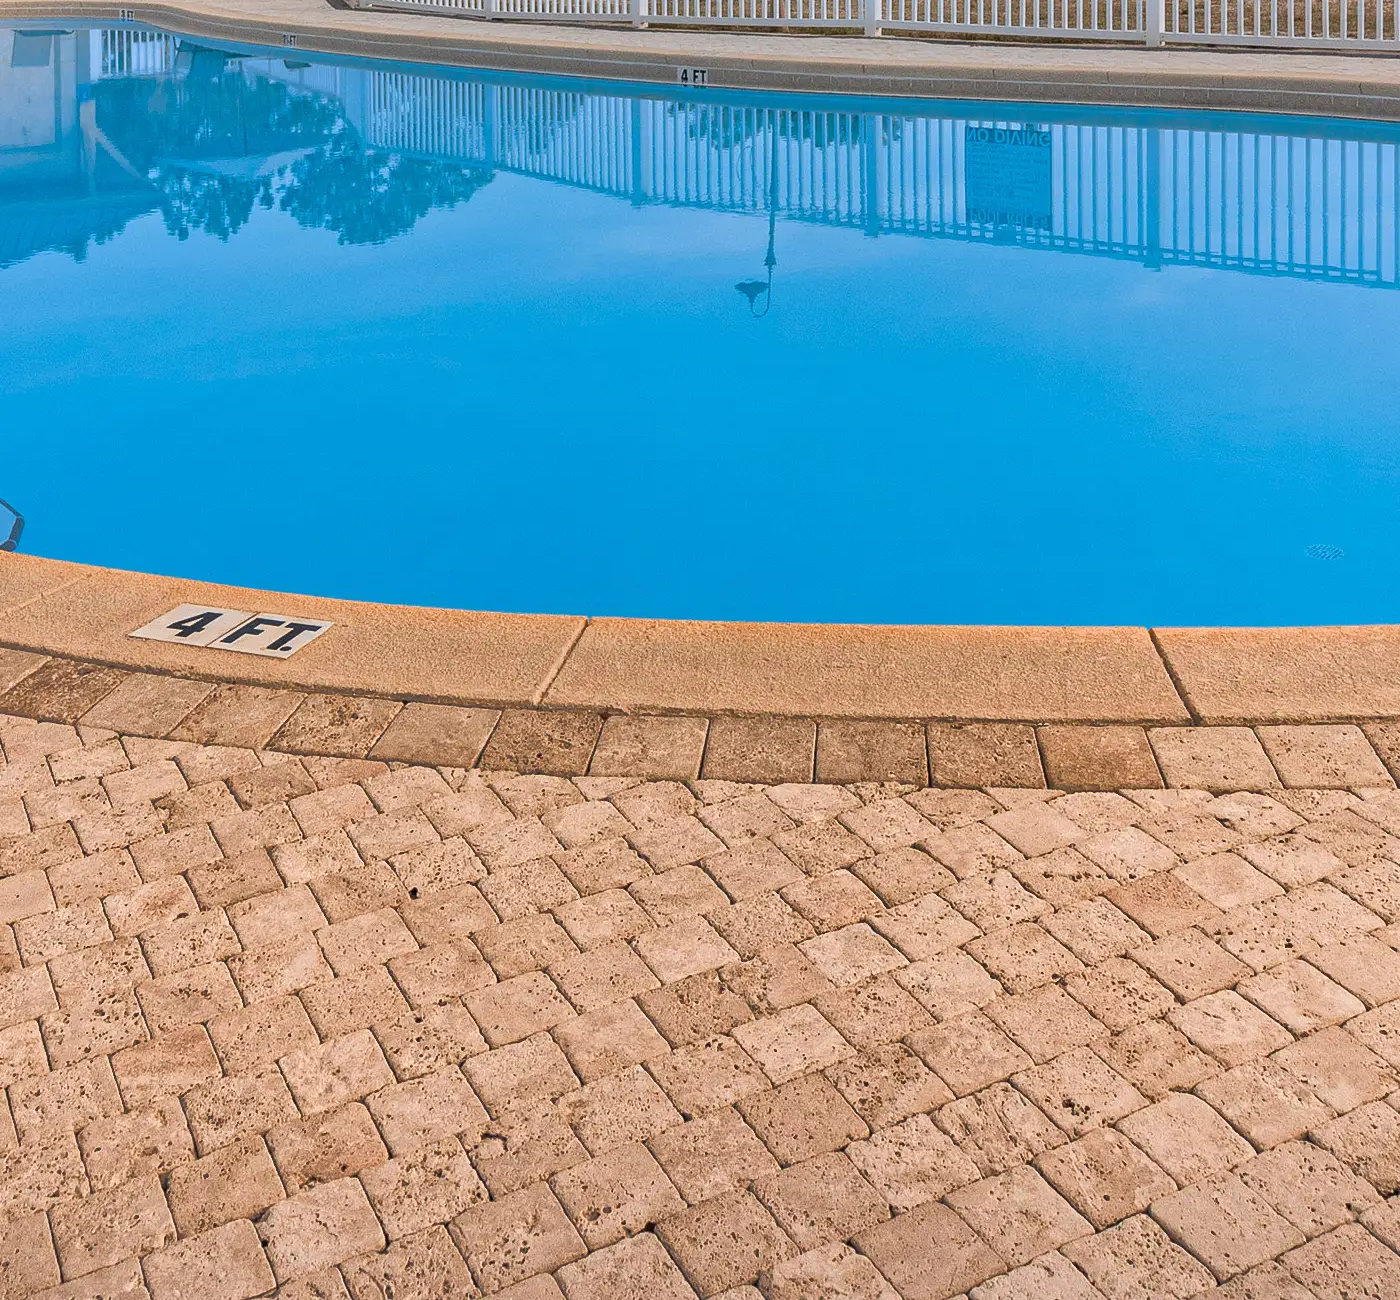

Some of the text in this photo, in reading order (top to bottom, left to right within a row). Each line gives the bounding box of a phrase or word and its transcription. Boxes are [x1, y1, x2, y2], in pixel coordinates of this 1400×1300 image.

[681, 69, 706, 84] 4 FT
[166, 612, 322, 652] 4 FT.
